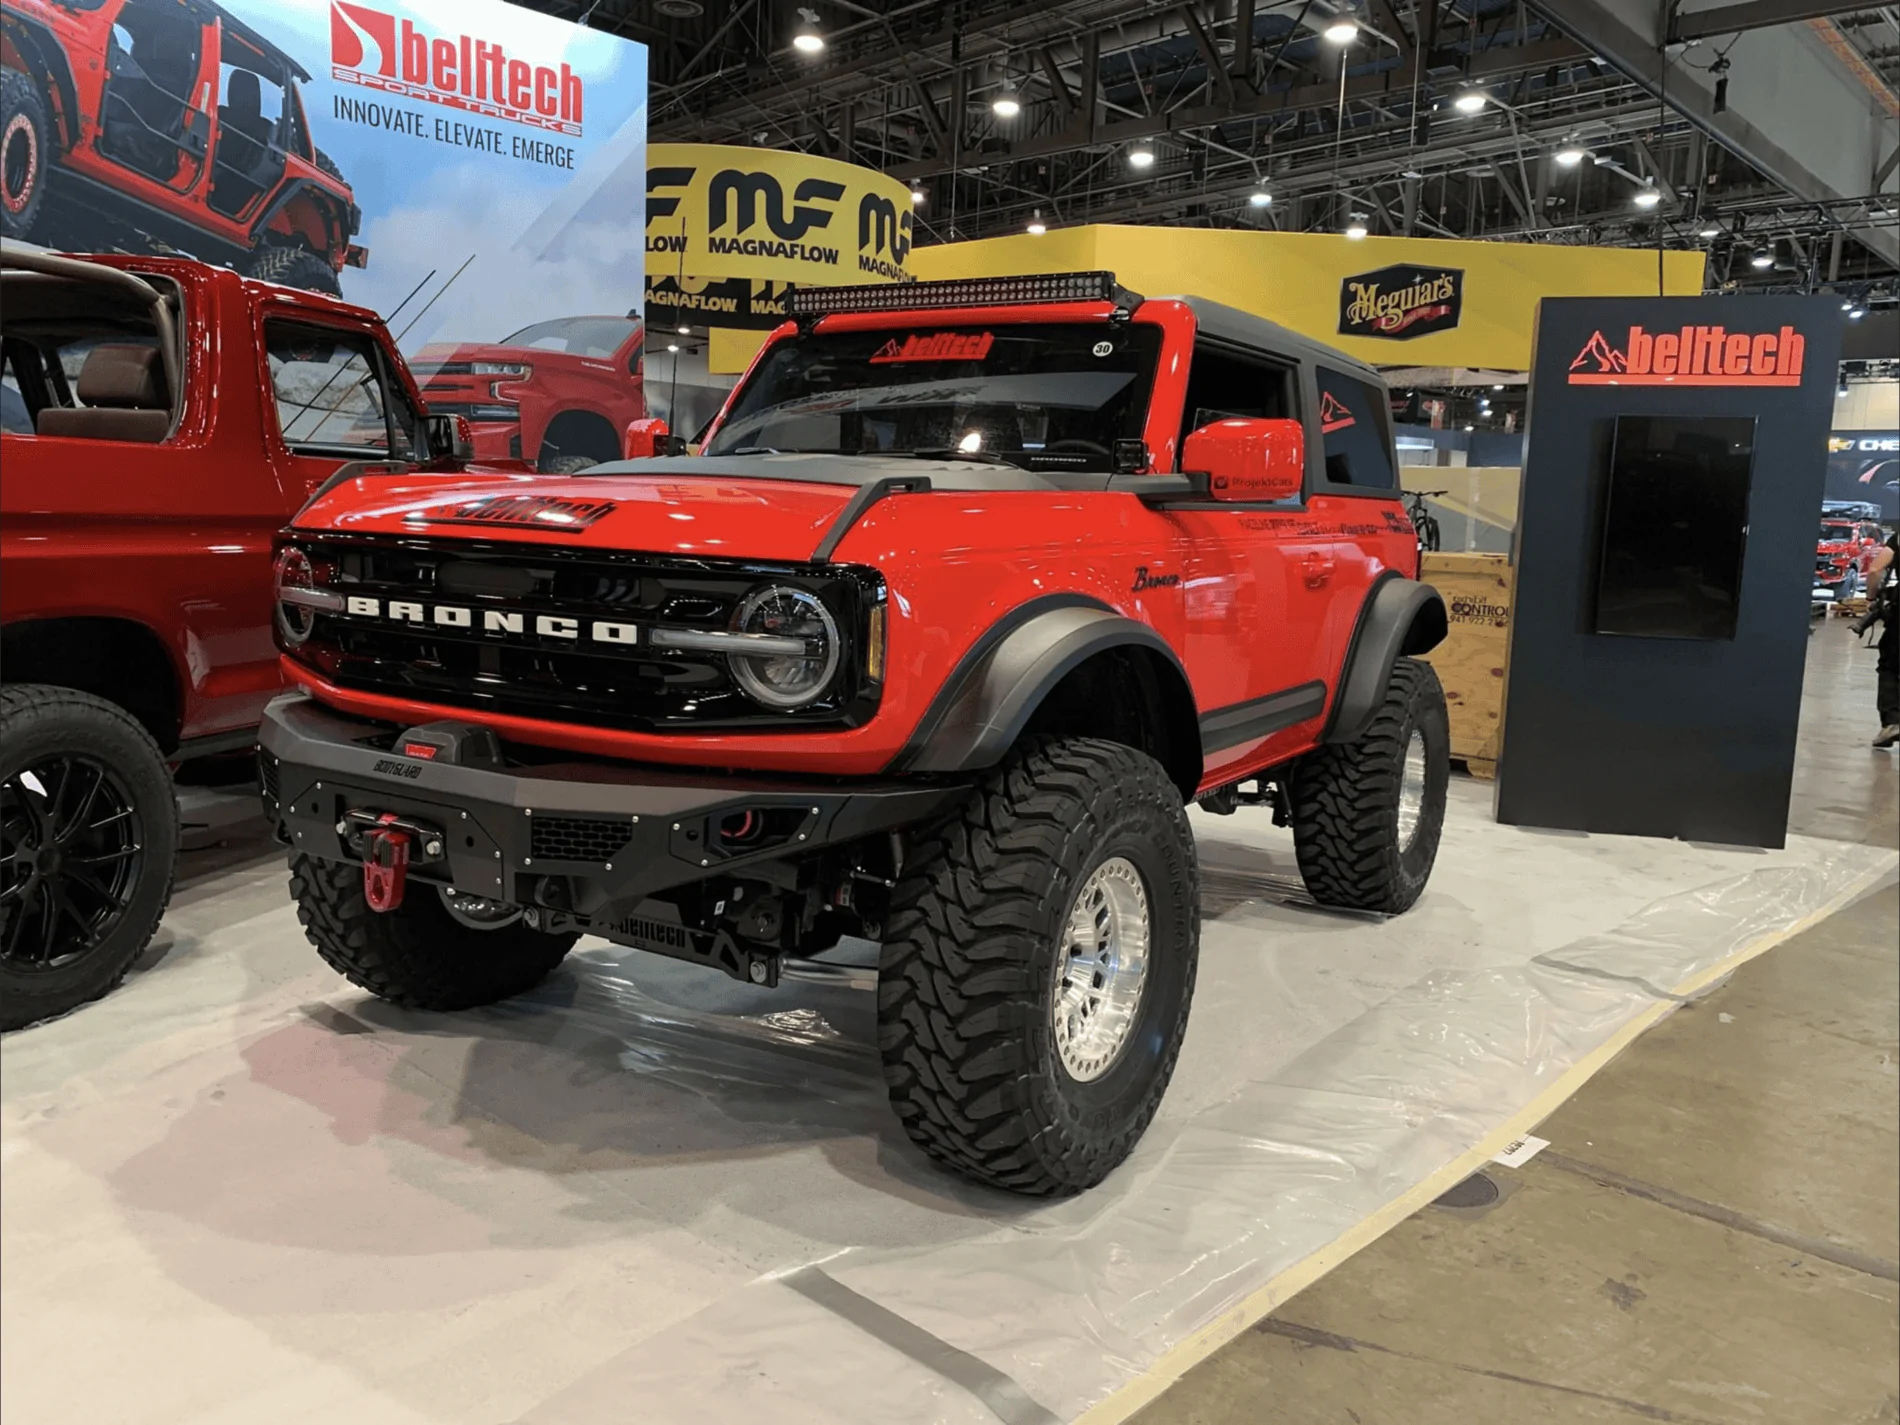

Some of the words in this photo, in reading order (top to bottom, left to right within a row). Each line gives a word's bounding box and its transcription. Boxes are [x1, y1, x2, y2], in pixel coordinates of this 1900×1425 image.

[401, 18, 583, 124] belltech
[333, 67, 449, 104] SPORT
[464, 97, 582, 136] TRUCKS
[334, 95, 429, 139] INNOVATE.
[435, 118, 507, 157] ELEVATE.
[512, 136, 575, 170] EMERGE
[708, 236, 839, 265] MAGNAFLOW
[1346, 272, 1454, 330] Meguiar's
[1095, 343, 1111, 354] 30
[1626, 326, 1805, 375] belltech
[1131, 566, 1180, 592] Bronco
[347, 596, 638, 645] BRONCO
